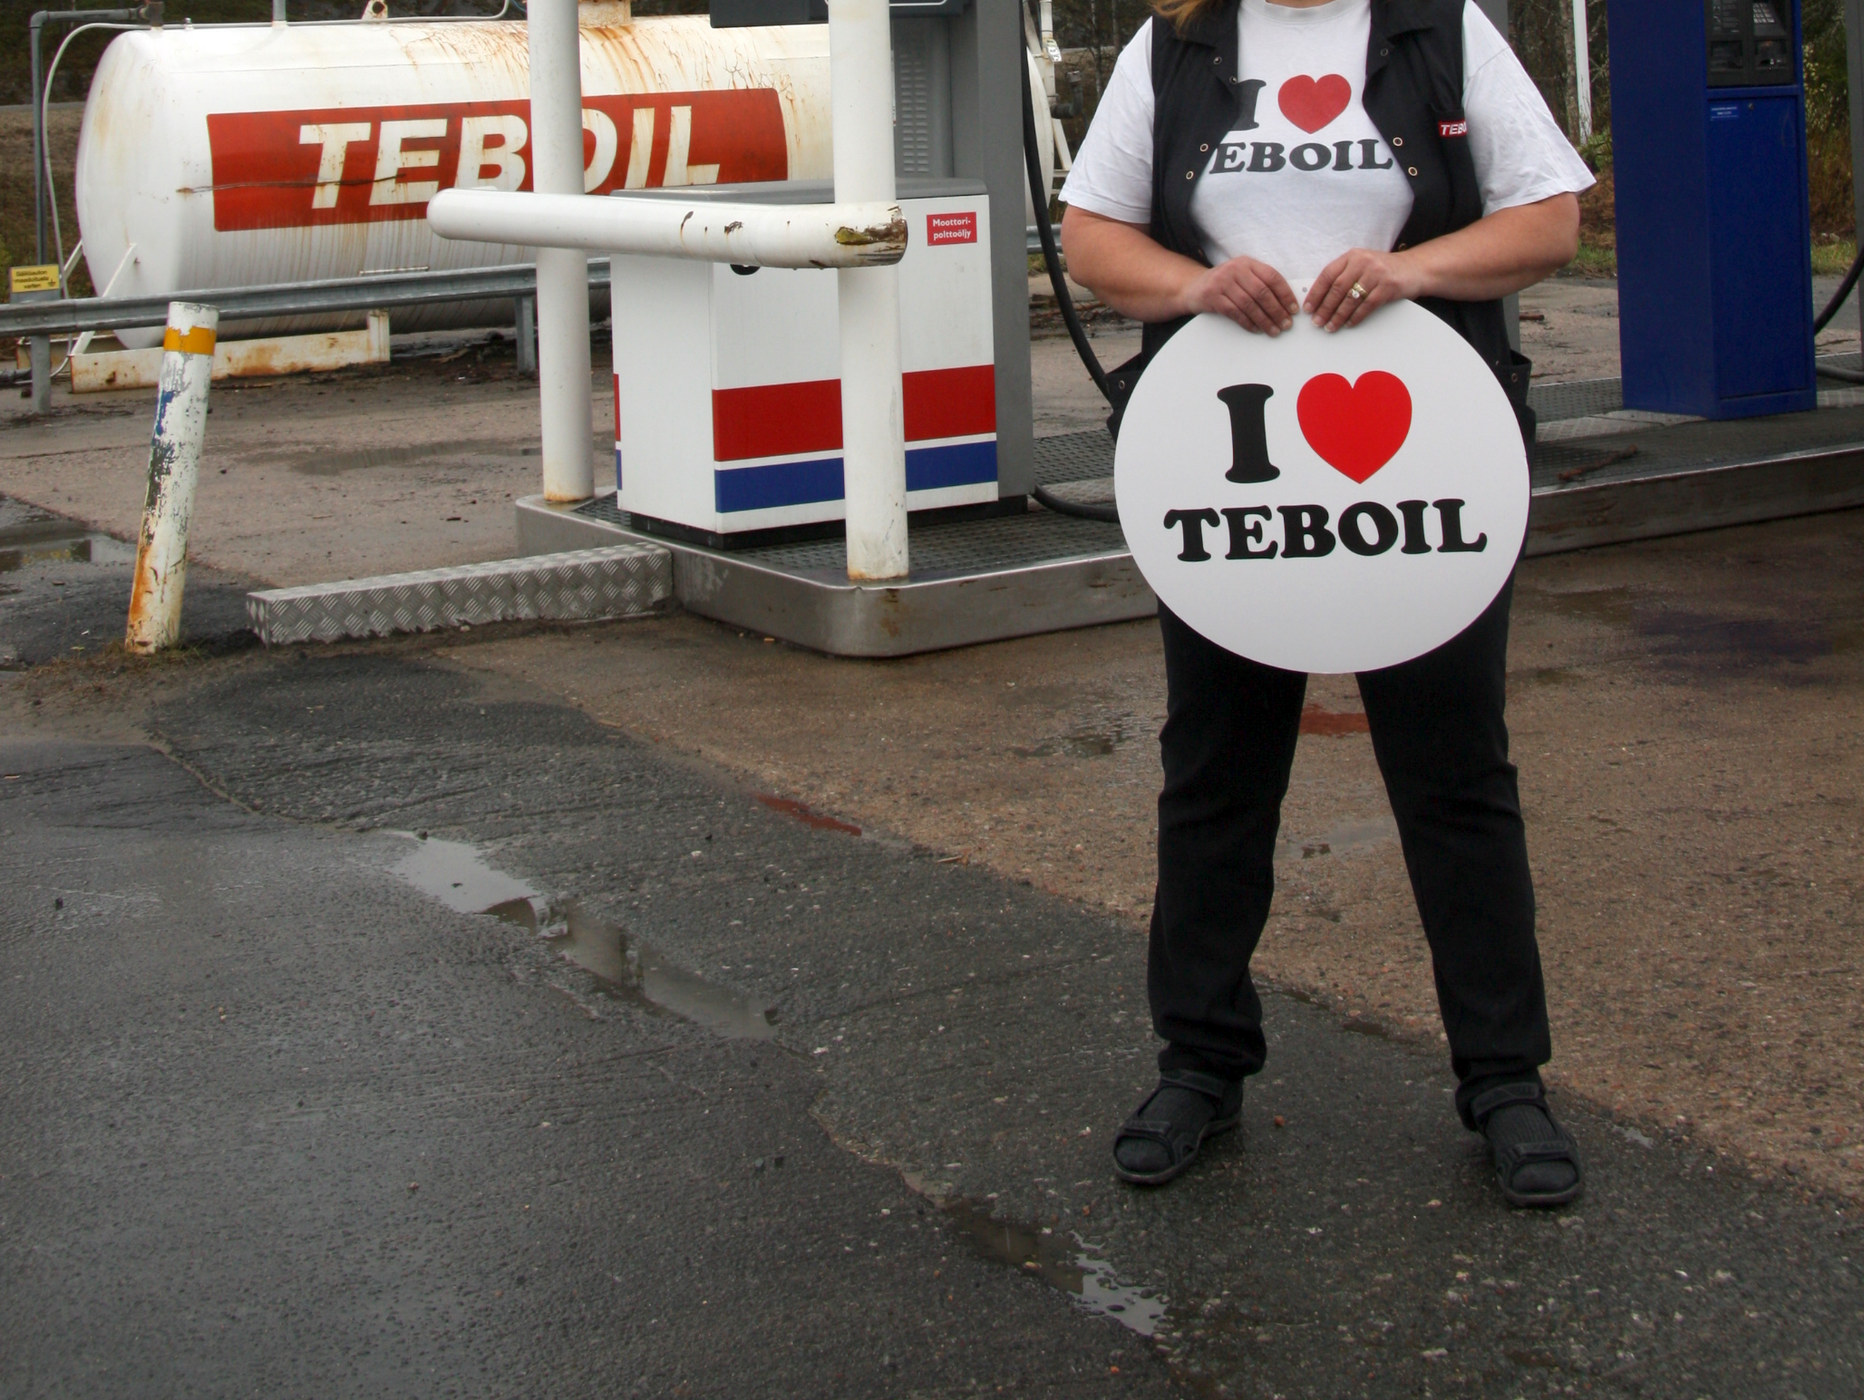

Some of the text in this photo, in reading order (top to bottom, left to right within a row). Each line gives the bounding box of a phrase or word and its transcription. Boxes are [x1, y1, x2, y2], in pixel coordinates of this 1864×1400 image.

[1228, 78, 1267, 132] I
[1209, 139, 1394, 175] EBOIL
[932, 217, 971, 227] Moottori-
[933, 229, 971, 241] polttoöljy
[1217, 383, 1281, 484] I
[1163, 498, 1488, 562] TEBOIL
